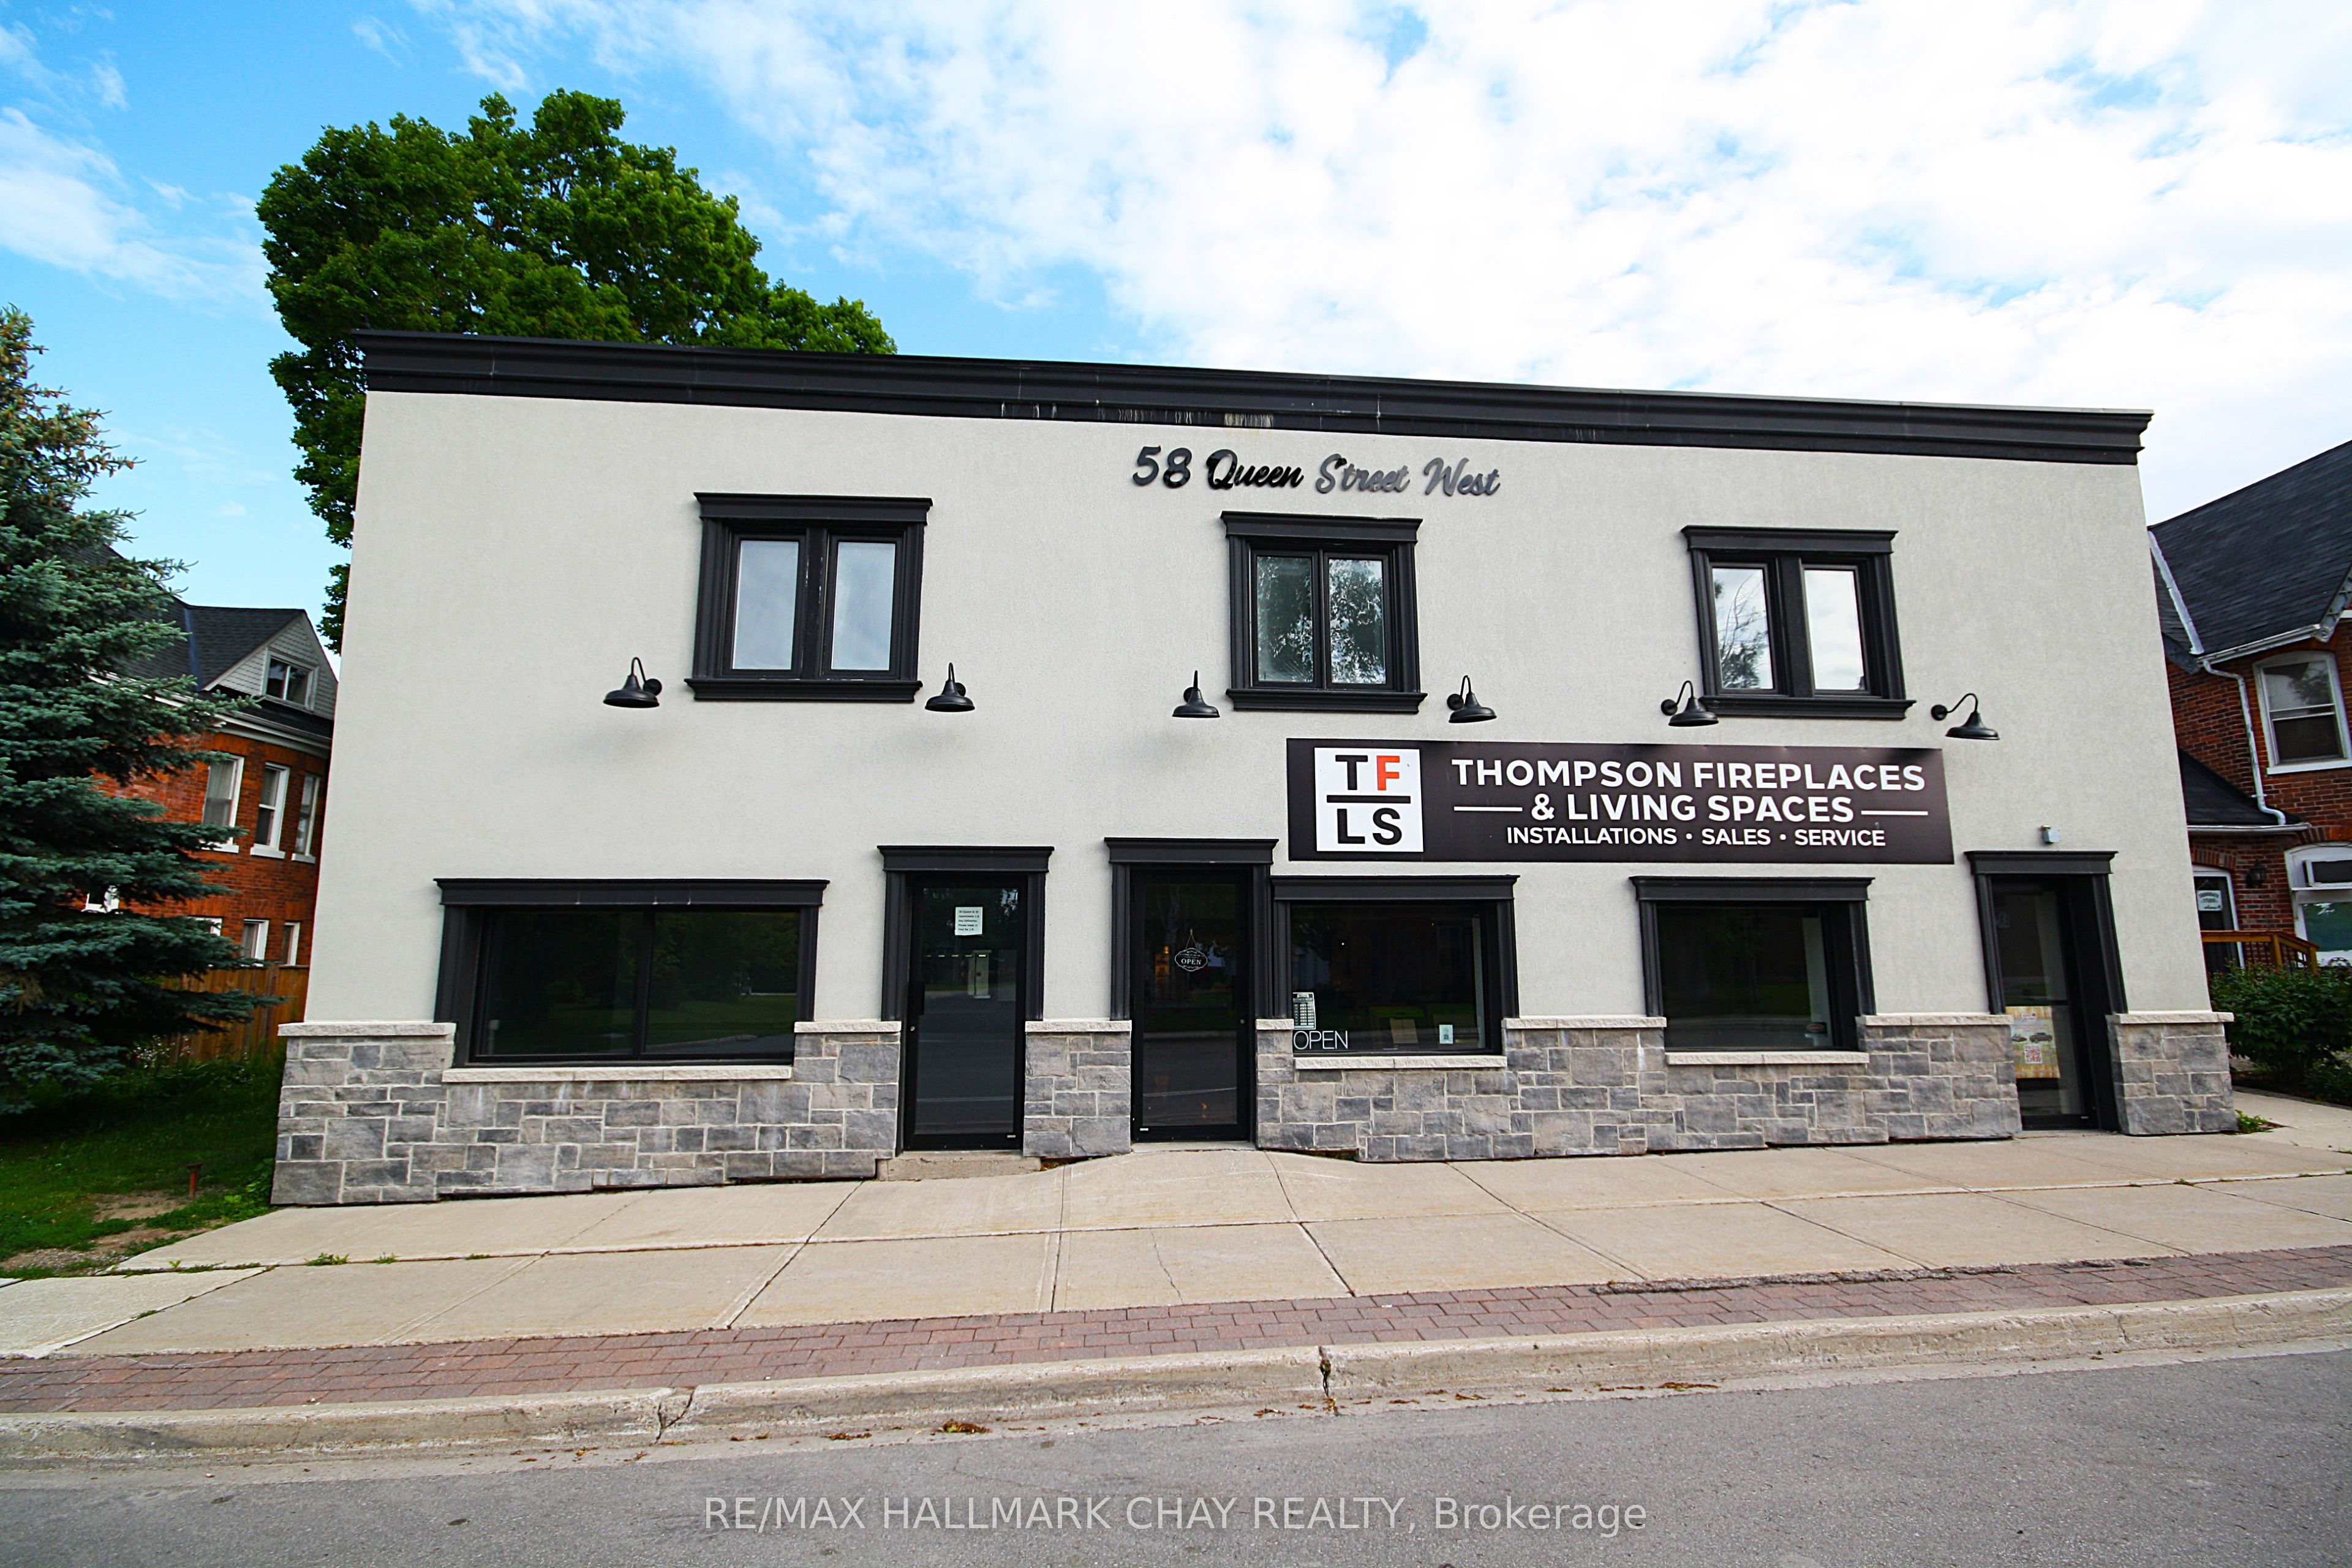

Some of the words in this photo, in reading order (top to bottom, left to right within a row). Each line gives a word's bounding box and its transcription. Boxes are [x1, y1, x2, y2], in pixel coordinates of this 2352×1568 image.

[1133, 445, 1193, 489] 58
[1206, 449, 1304, 489] Queen
[1316, 453, 1410, 494] Street
[1423, 457, 1501, 496] West
[1451, 759, 1681, 788] THOMPSON
[1693, 762, 1925, 791] FIREPLACES
[1531, 793, 1555, 821] &
[1567, 794, 1696, 821] LIVING
[1708, 795, 1854, 823] SPACES
[1336, 808, 1403, 845] LS
[1507, 827, 1678, 845] INSTALLATIONS
[1702, 829, 1771, 846] SALES
[1794, 829, 1886, 846] SERVICE
[1293, 1030, 1348, 1050] OPEN
